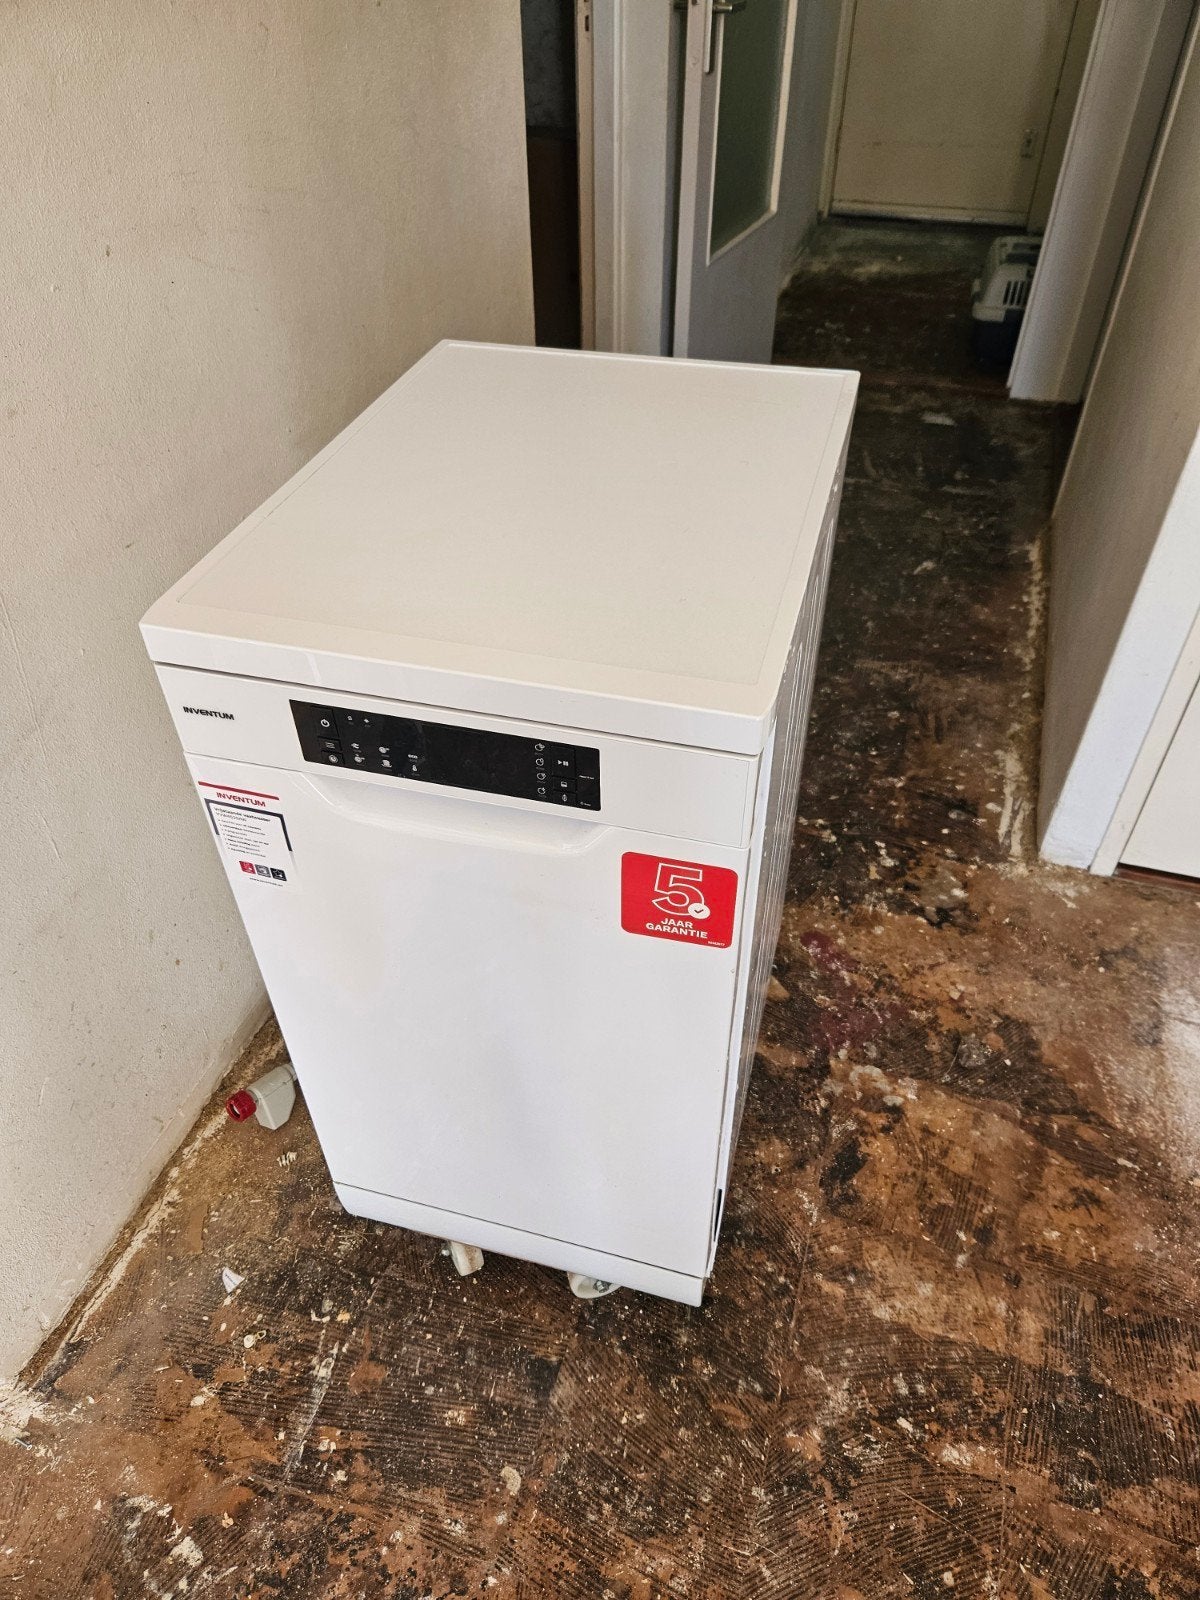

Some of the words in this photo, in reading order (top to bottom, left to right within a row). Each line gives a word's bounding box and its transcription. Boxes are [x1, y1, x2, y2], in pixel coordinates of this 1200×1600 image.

[183, 706, 235, 720] INVENTUM
[216, 792, 266, 807] INVENTUM
[652, 863, 705, 916] 5
[645, 922, 708, 939] GARANTIE
[661, 918, 693, 929] JAAR
